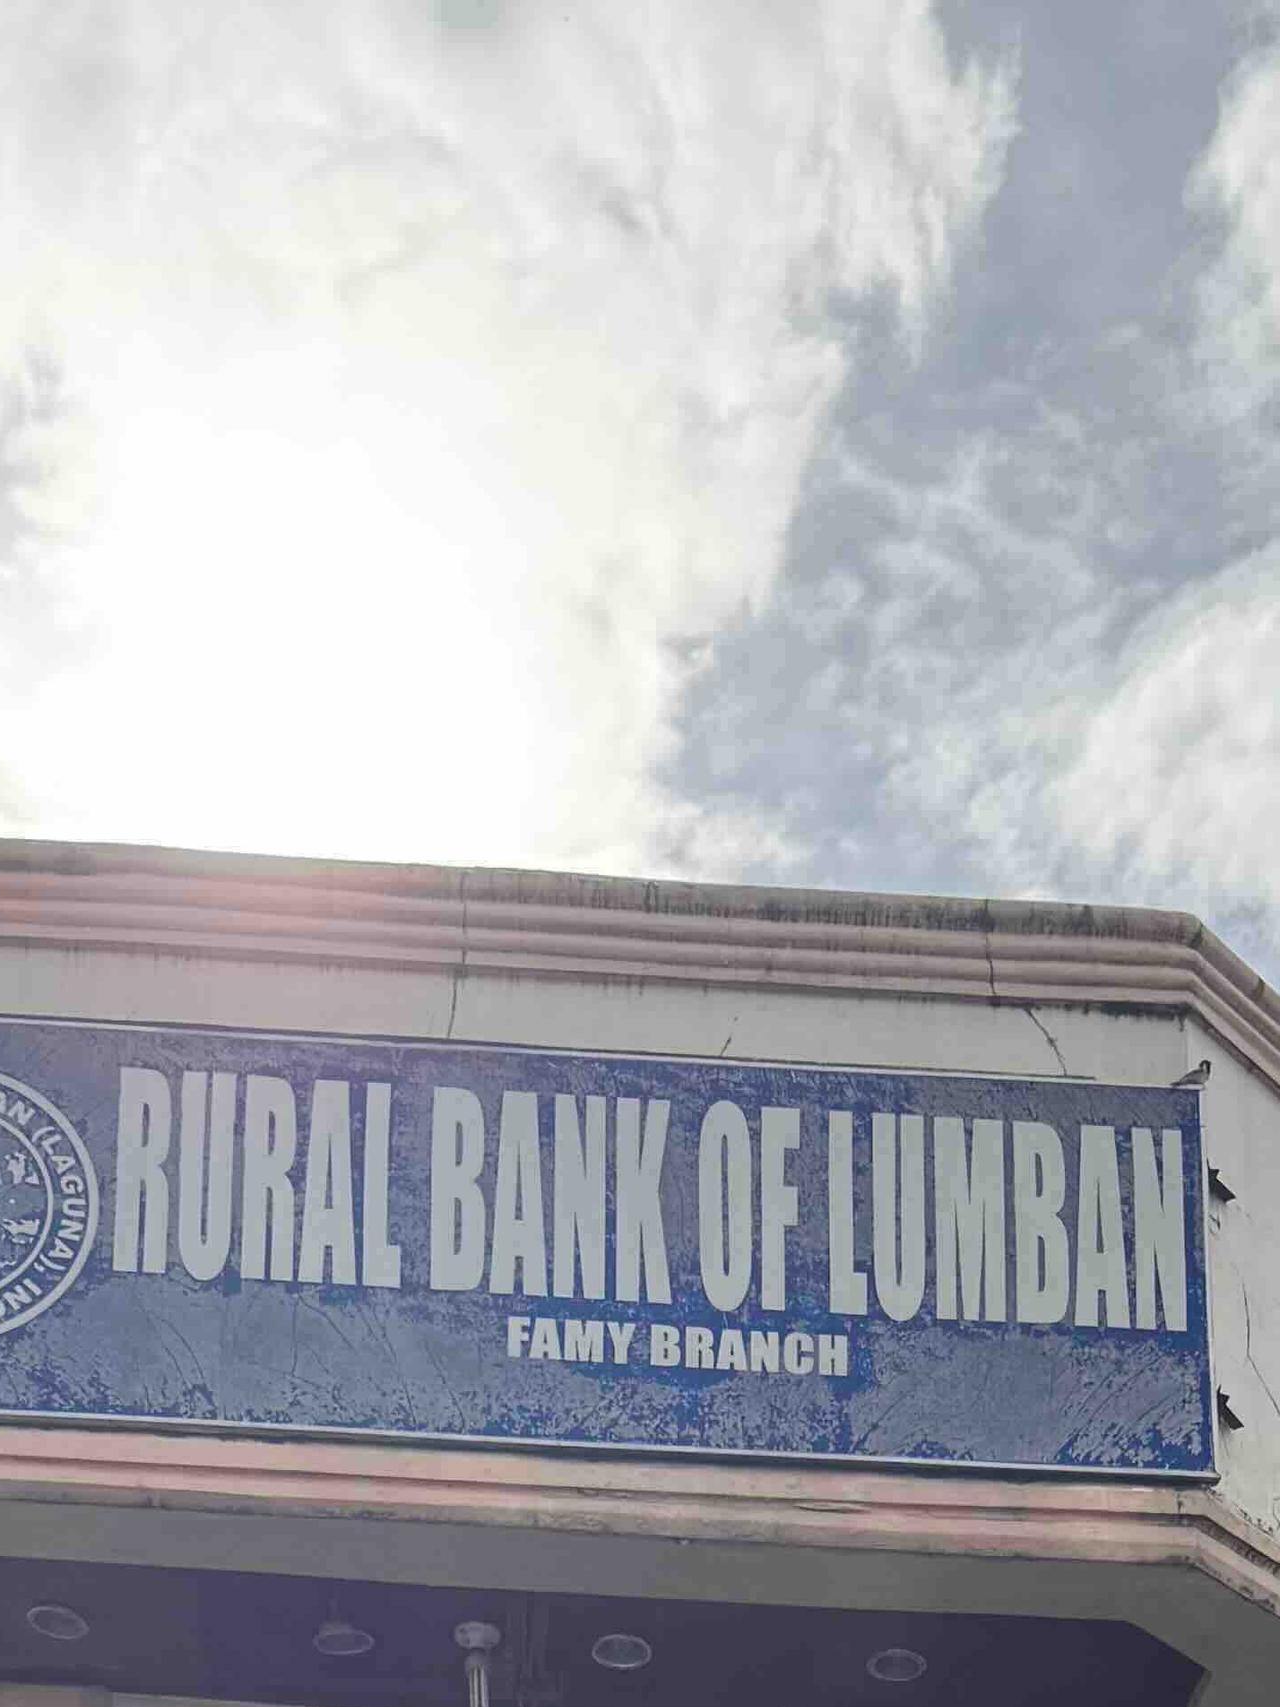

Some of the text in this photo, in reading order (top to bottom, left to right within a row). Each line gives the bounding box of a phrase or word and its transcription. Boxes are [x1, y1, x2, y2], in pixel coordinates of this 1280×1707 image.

[113, 1067, 1187, 1332] RURAL BANK OF LUMBAN
[507, 1317, 848, 1377] FAMY BRANCH
